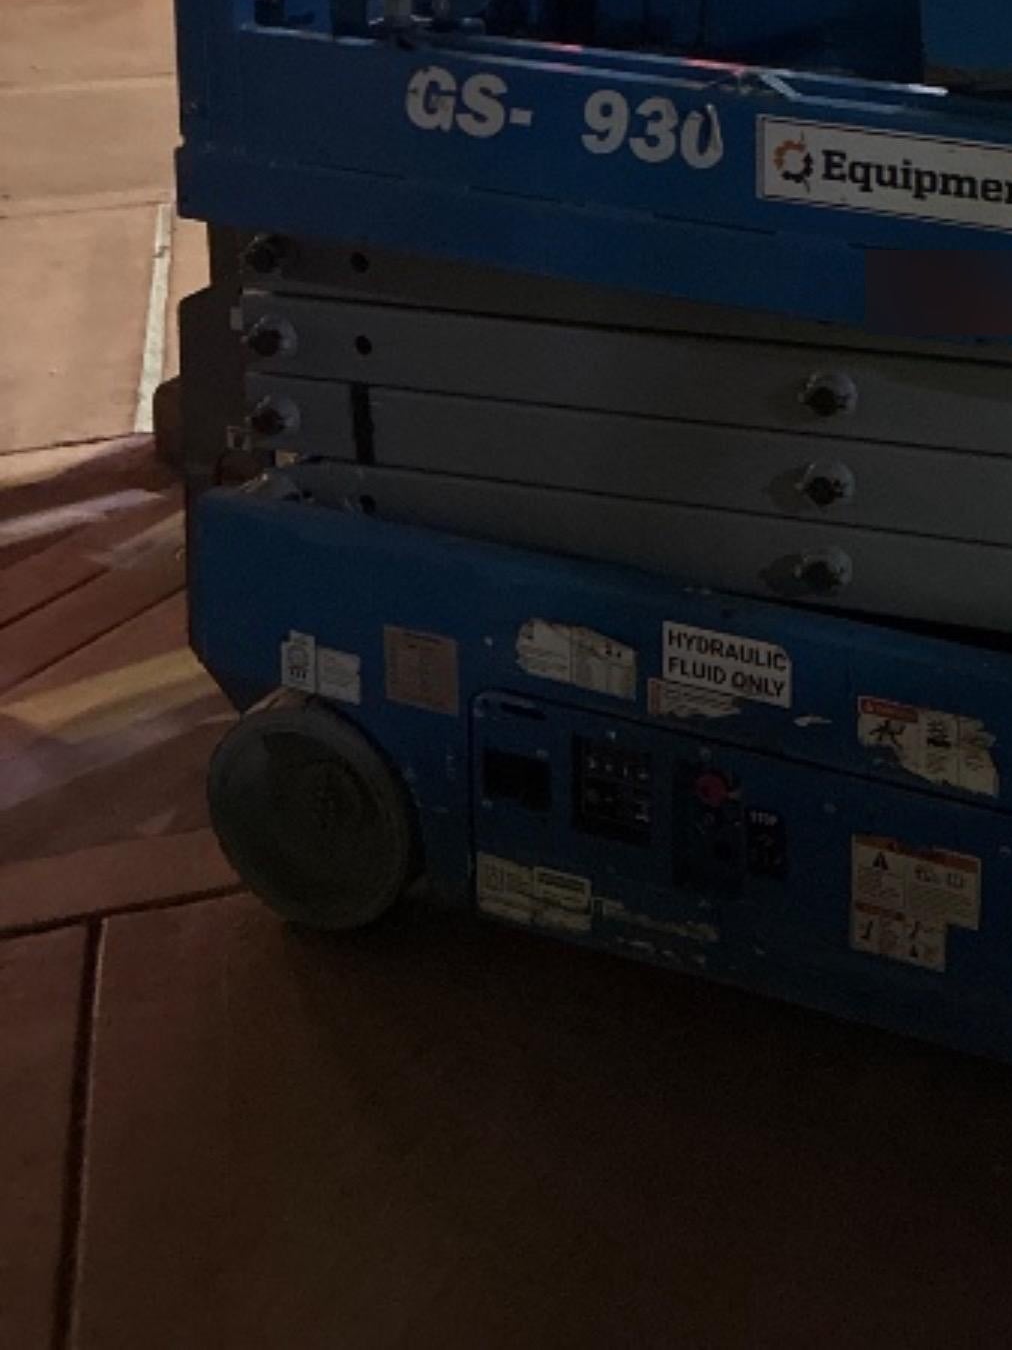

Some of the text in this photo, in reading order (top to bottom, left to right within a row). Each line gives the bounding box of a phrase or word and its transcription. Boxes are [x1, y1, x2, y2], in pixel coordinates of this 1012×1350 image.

[405, 65, 725, 170] GS- 930
[668, 629, 787, 670] HYDRAULIC
[668, 657, 785, 698] FLUID ONLY
